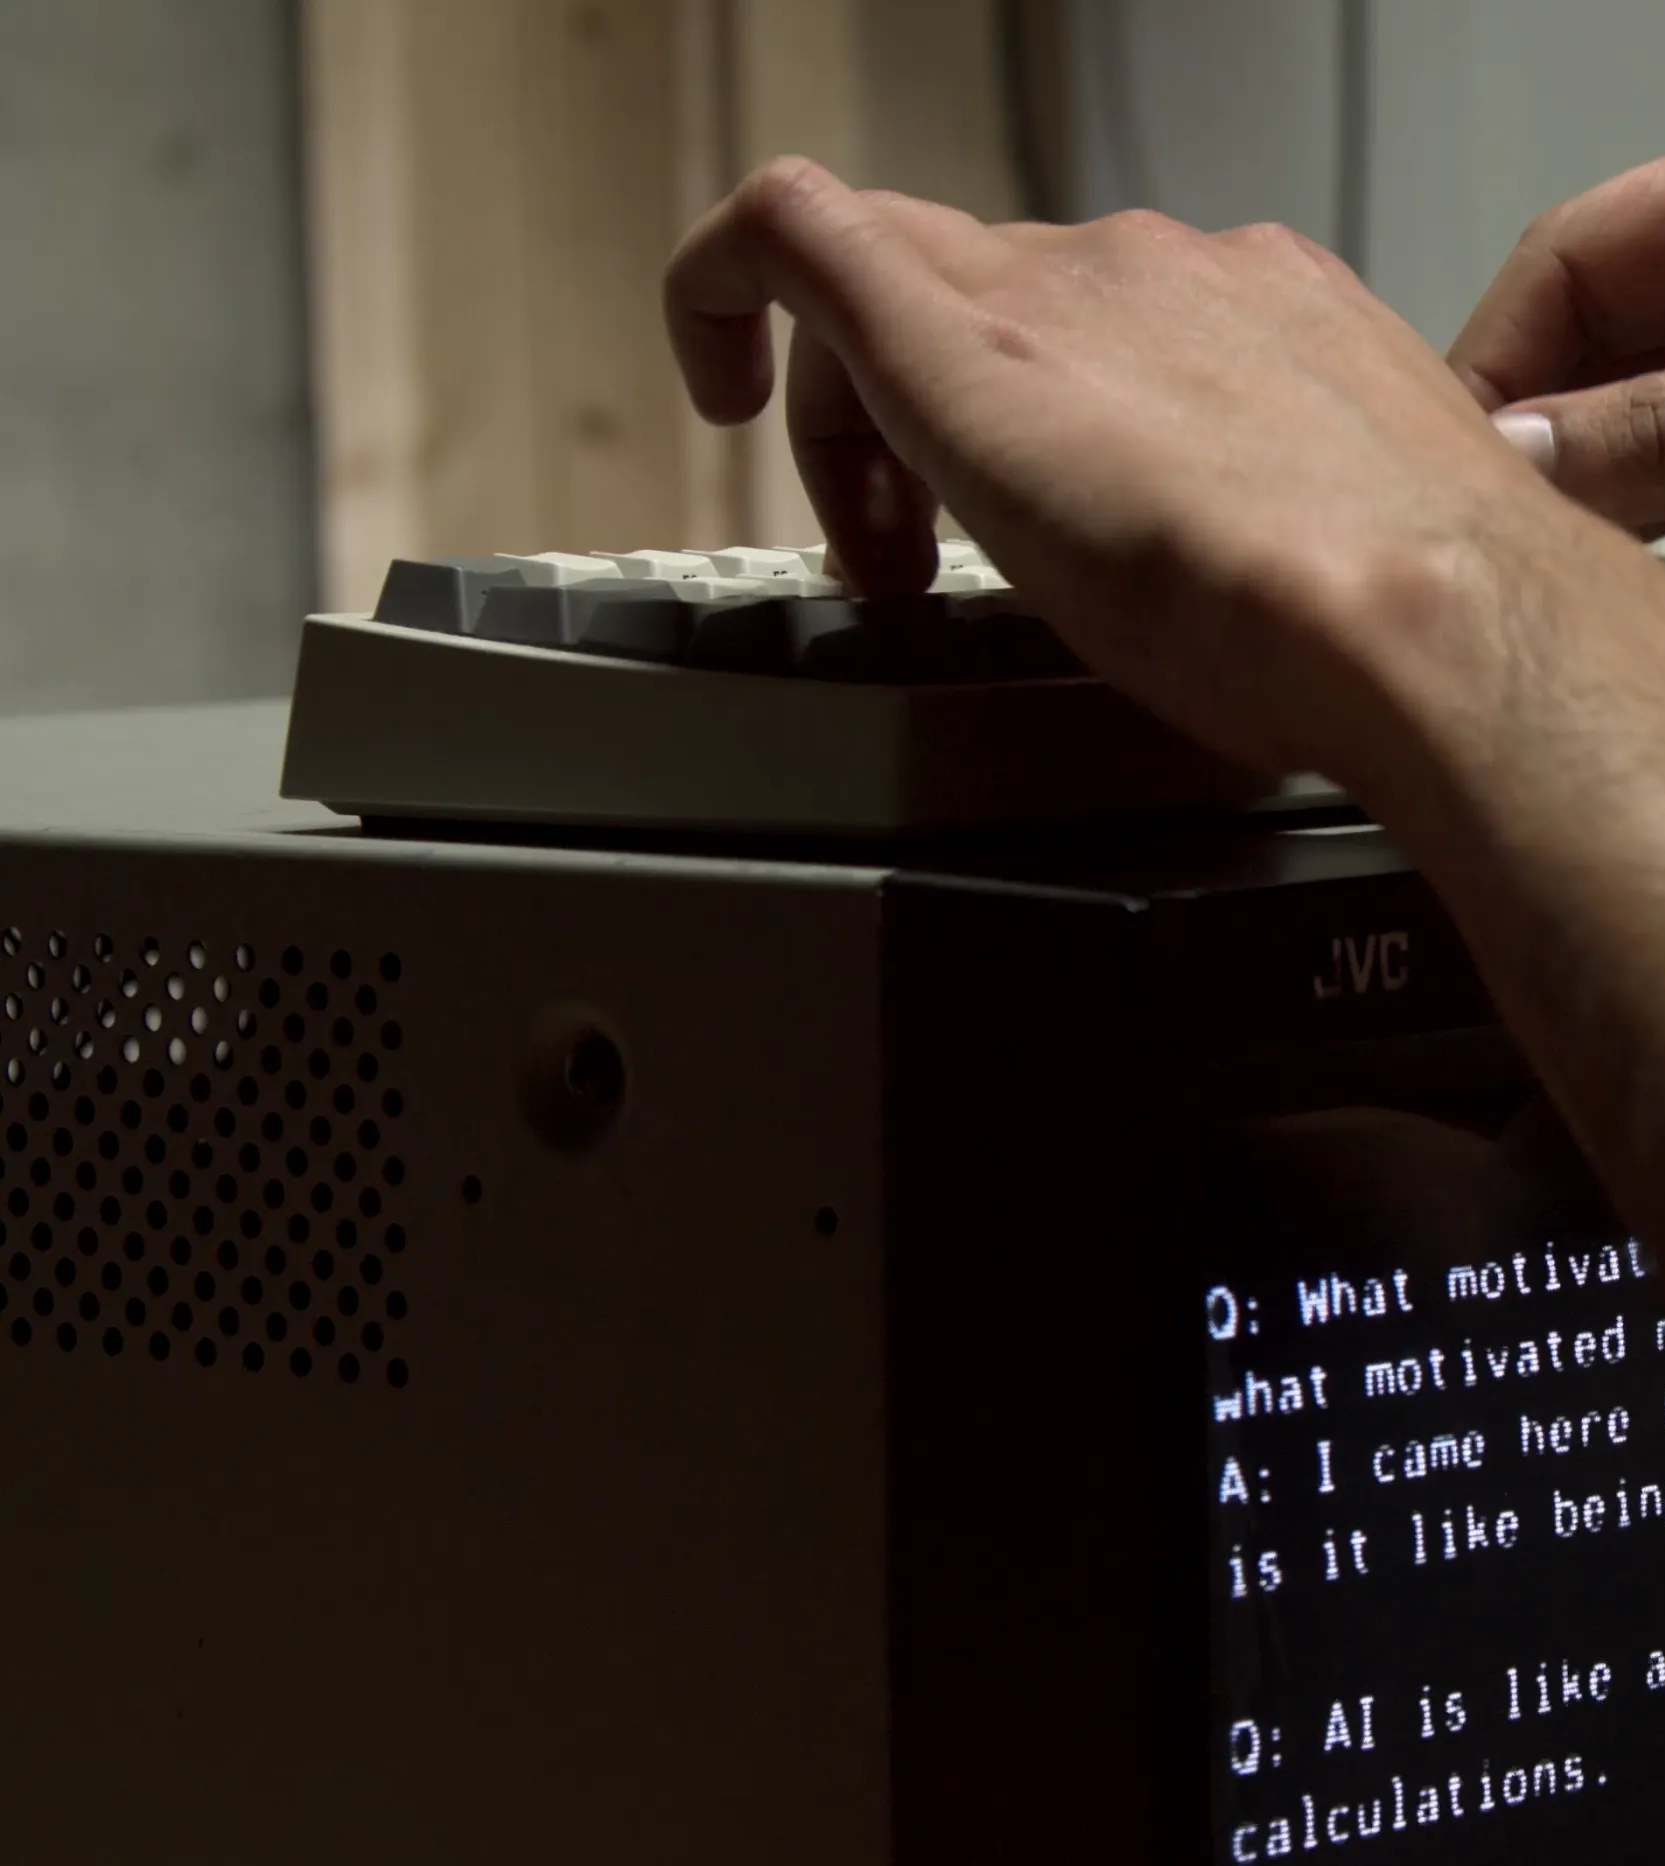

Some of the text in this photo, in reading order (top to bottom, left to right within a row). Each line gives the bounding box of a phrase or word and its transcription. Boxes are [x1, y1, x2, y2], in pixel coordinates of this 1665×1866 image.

[1312, 929, 1409, 1000] JVC
[1297, 1269, 1413, 1325] What
[1213, 1365, 1328, 1422] what
[1364, 1314, 1626, 1397] motivated
[1219, 1456, 1271, 1503] A:
[1316, 1440, 1336, 1493] I
[1372, 1429, 1485, 1484] came
[1520, 1406, 1630, 1454] here
[1229, 1543, 1283, 1598] is
[1322, 1527, 1369, 1581] it
[1411, 1504, 1520, 1565] like
[1230, 1719, 1282, 1776] Q:
[1323, 1695, 1376, 1752] AI
[1419, 1685, 1468, 1738] is
[1506, 1659, 1612, 1720] like
[1231, 1755, 1607, 1864] calculations.
